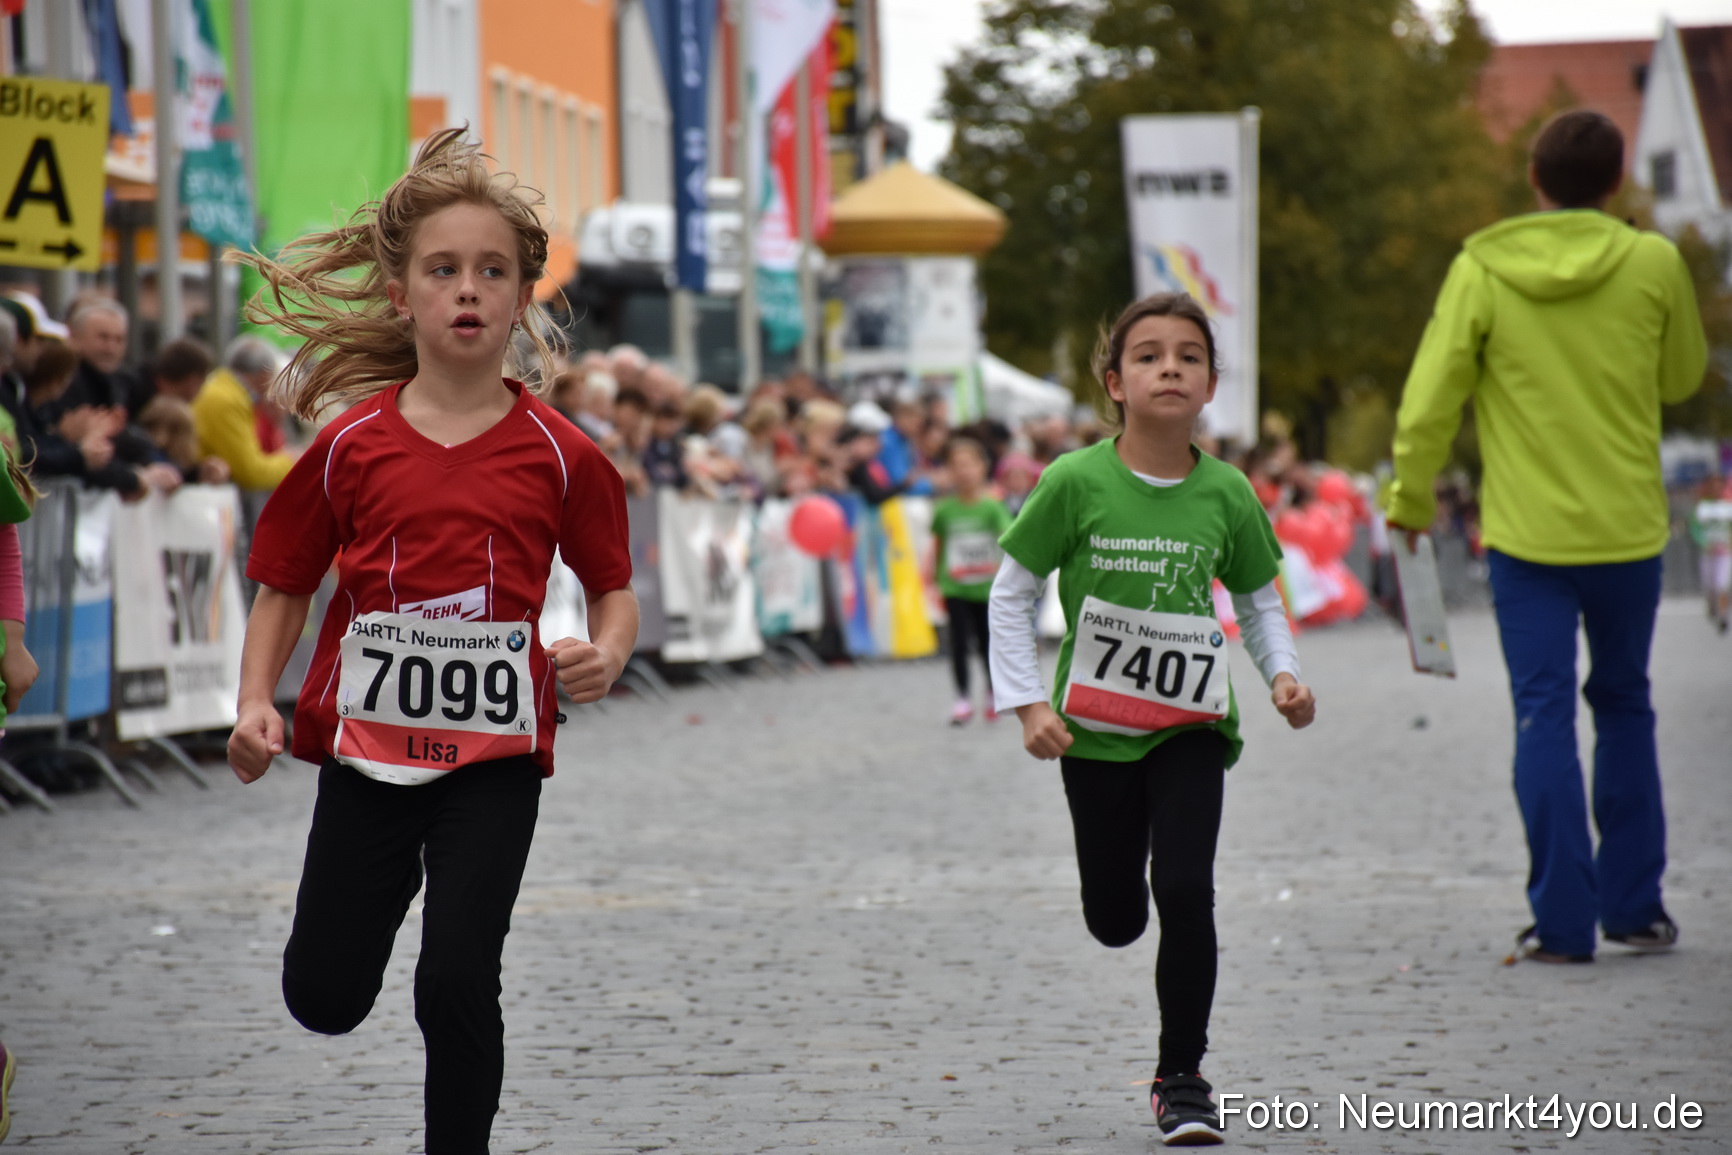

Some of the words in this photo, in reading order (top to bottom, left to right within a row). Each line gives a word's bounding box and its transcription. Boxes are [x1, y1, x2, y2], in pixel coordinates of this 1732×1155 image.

[0, 83, 95, 125] Block
[3, 136, 72, 226] A
[1090, 534, 1189, 554] Neumarkter
[1090, 554, 1169, 576] Stadtlauf
[351, 621, 406, 643] PARTL
[411, 629, 501, 649] Neumarkt
[1083, 611, 1134, 634] PARTL
[1138, 625, 1205, 645] Neumarkt
[1094, 634, 1215, 704] 7407
[362, 647, 519, 725] 7099
[341, 705, 349, 716] 3
[519, 720, 527, 731] K
[407, 736, 459, 764] Lisa
